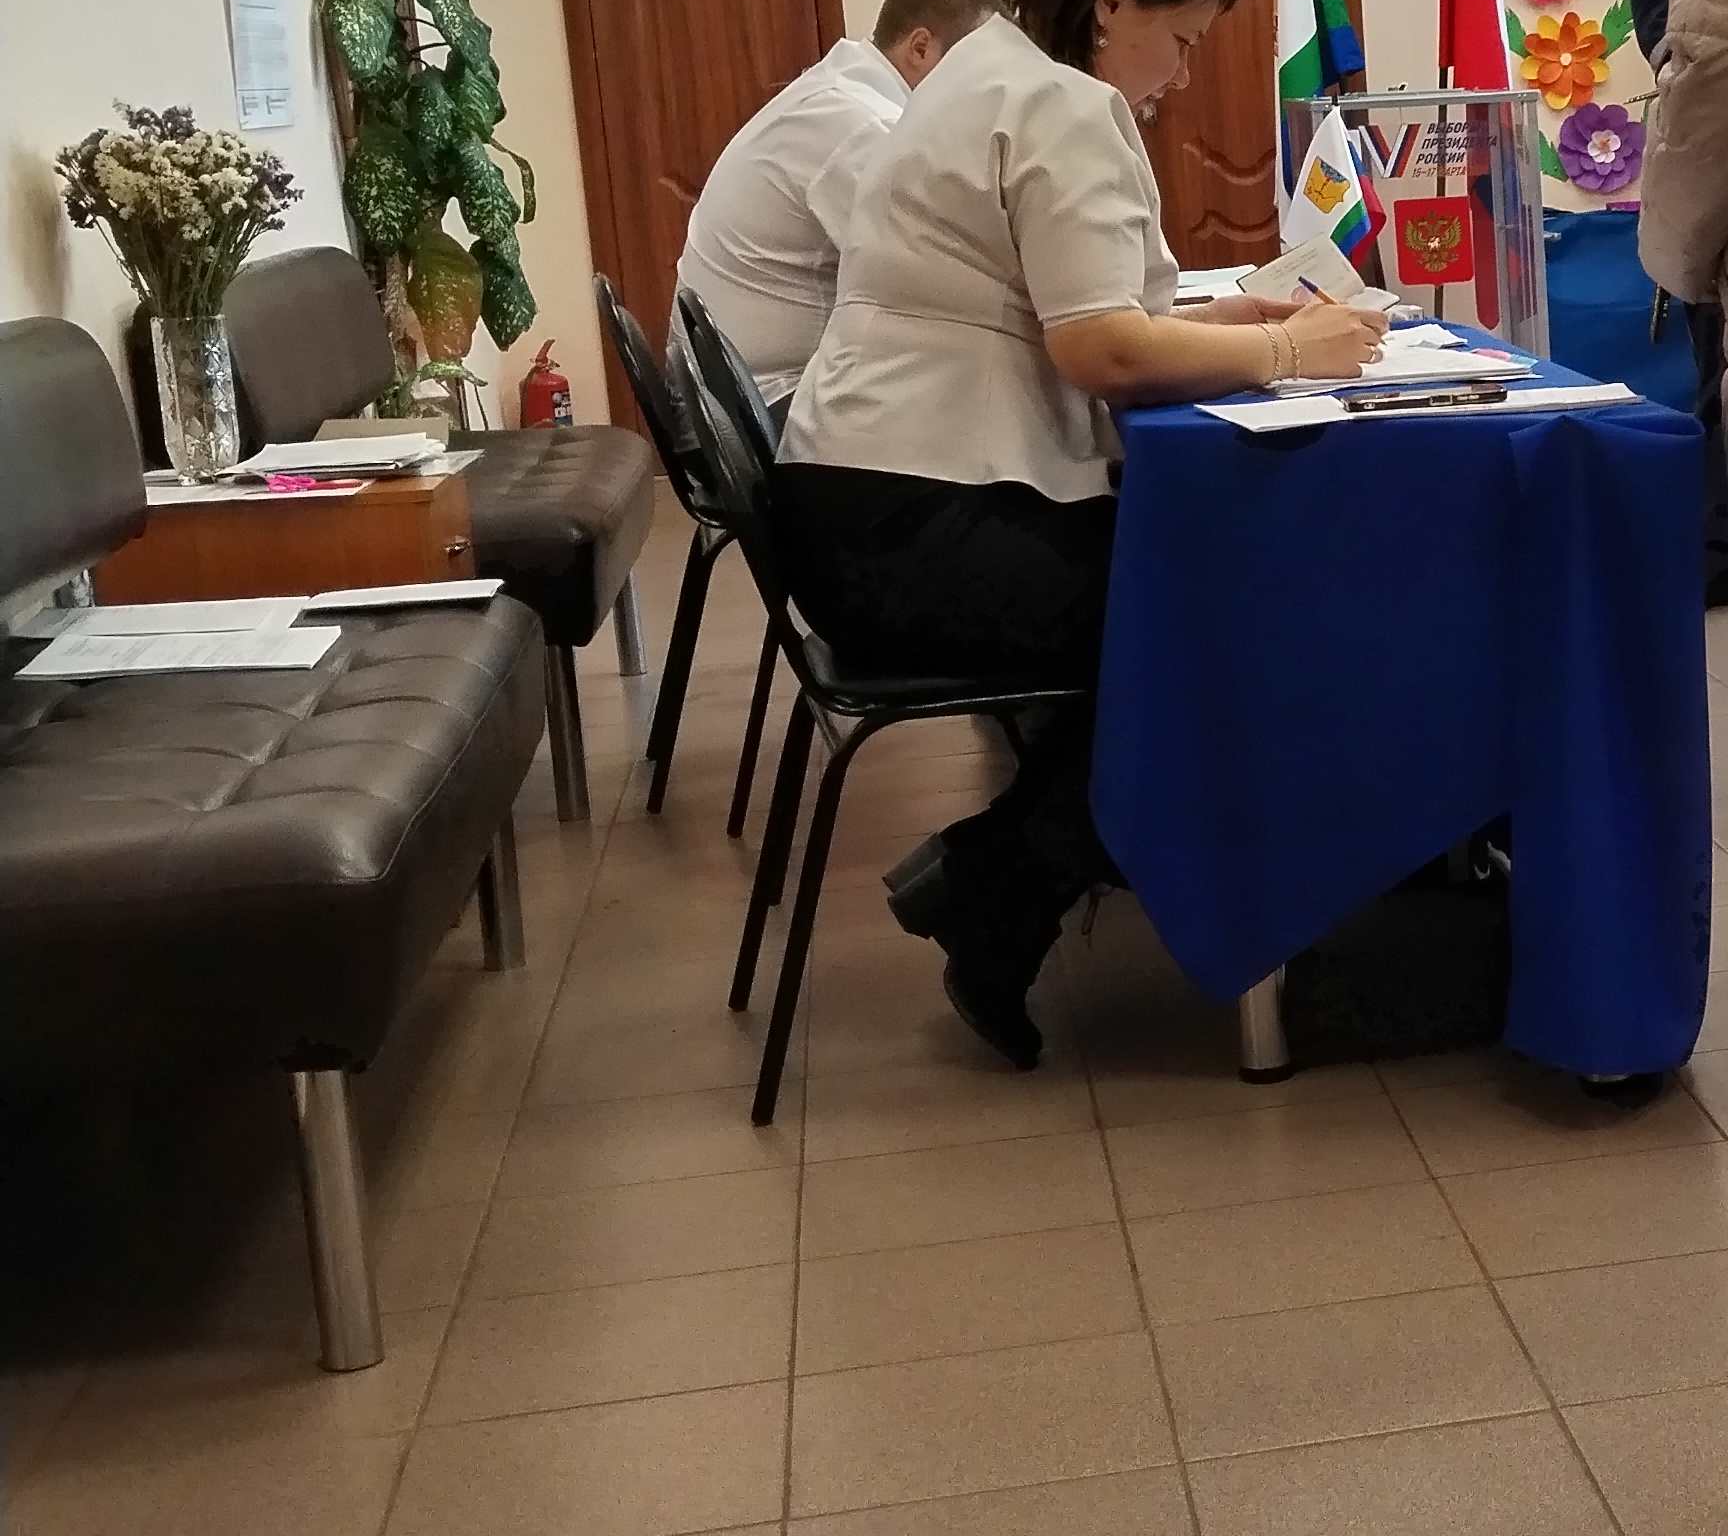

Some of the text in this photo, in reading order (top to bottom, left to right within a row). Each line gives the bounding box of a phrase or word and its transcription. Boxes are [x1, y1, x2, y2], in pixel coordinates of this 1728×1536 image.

[1427, 122, 1479, 134] ВЫБОРЫ
[1421, 135, 1498, 150] ПРЕЗИДЕНТА
[1415, 152, 1466, 165] РОССИИ
